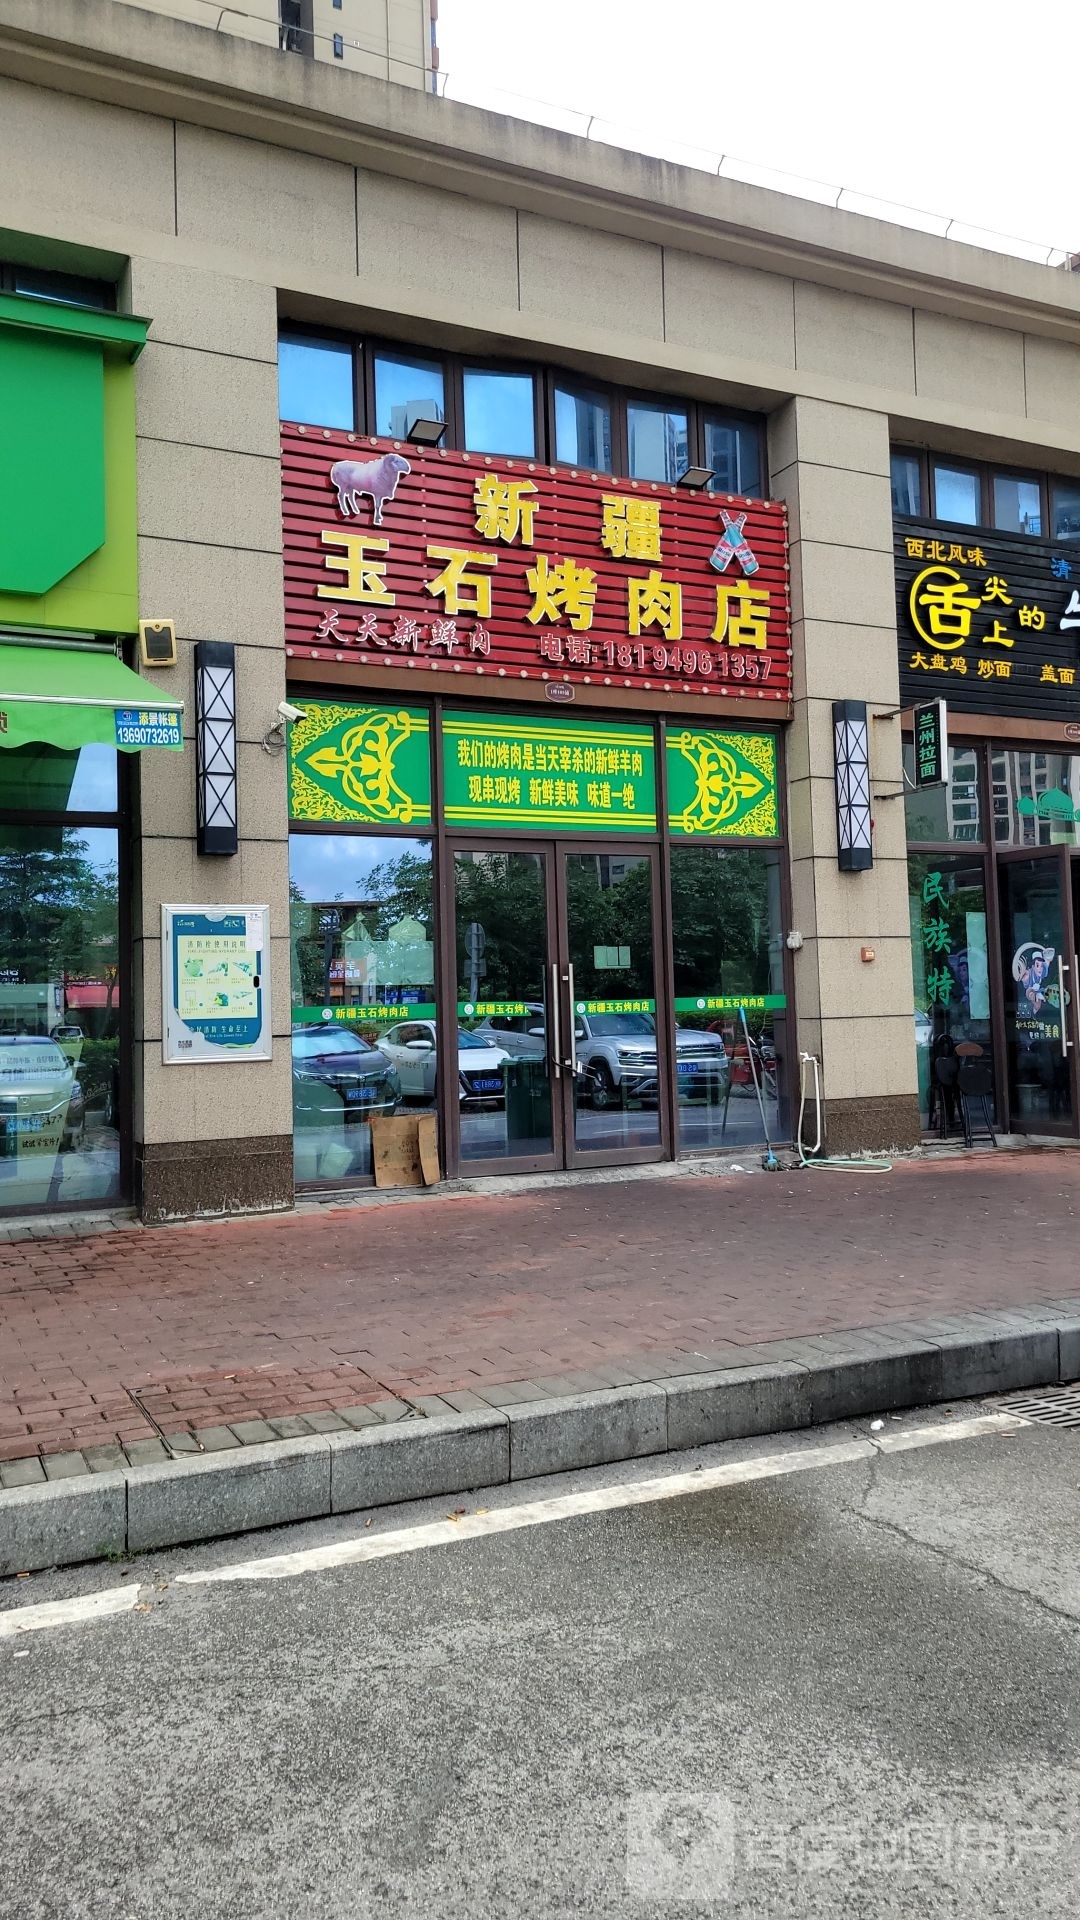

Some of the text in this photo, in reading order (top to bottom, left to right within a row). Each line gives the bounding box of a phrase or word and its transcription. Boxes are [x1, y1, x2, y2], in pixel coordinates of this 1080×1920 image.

[473, 473, 663, 563] 新疆
[904, 537, 988, 567] 西北风味
[317, 530, 772, 650] 玉石烤肉店
[316, 608, 491, 656] 天天新鲜肉
[652, 645, 713, 675] 9496
[718, 651, 772, 680] 1357
[909, 651, 1076, 685] 大盘鸡 炒面 盖面
[117, 727, 180, 744] 13690732619
[918, 712, 937, 778] 兰州拉面
[457, 738, 643, 777] 我们的烤肉是当天宰杀的新鲜羊肉
[468, 775, 635, 810] 现串现烤 新鲜美味 味道一绝
[922, 871, 956, 1006] 民族特
[335, 1006, 409, 1019] 新疆玉石烤肉店
[587, 1001, 650, 1013] 新疆玉石烤肉店
[707, 996, 765, 1009] 新疆玉石烤肉店
